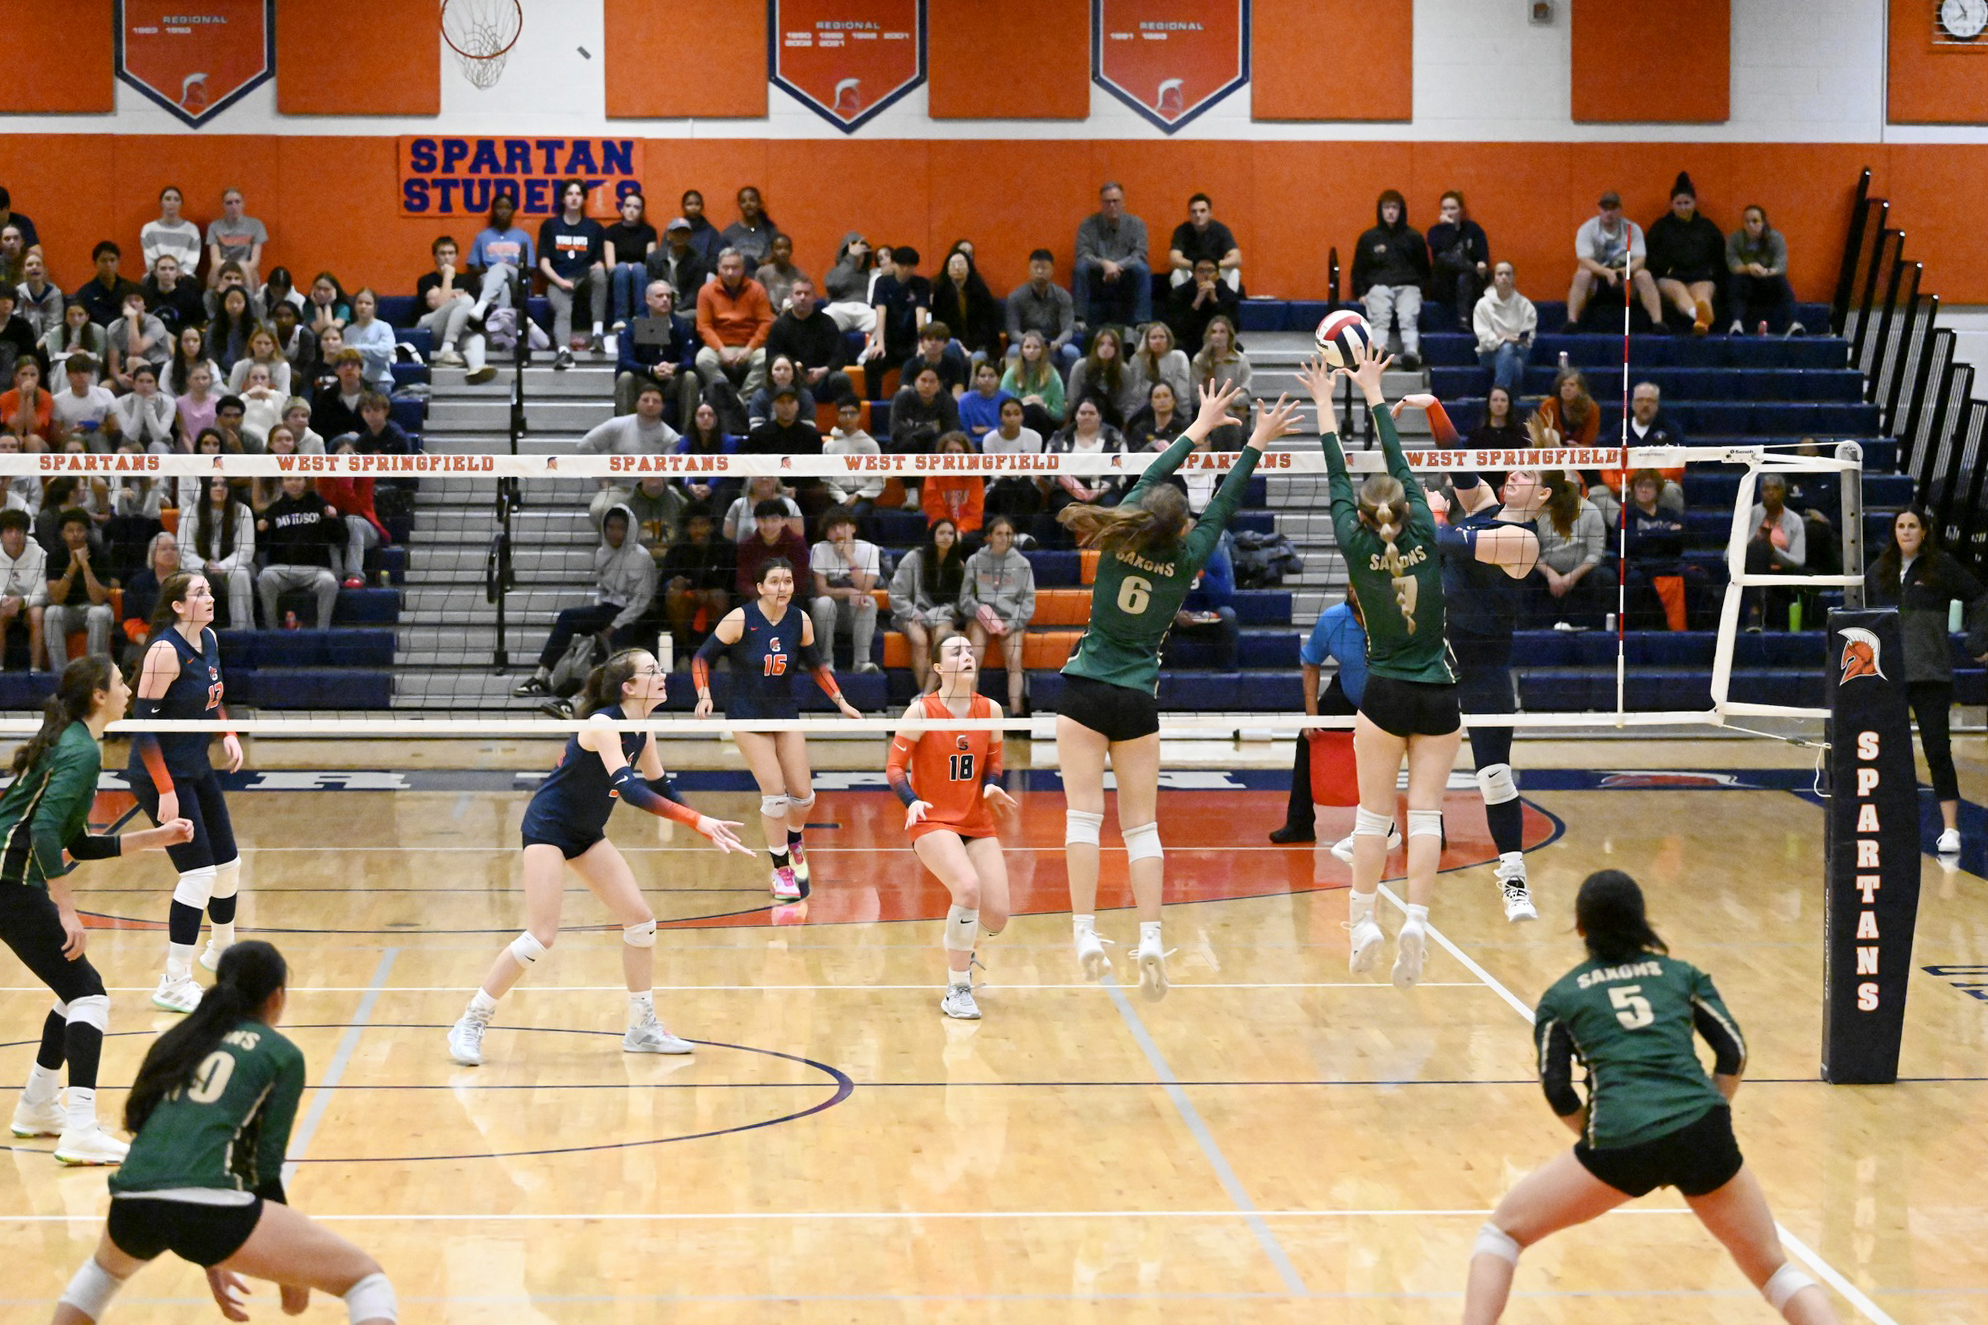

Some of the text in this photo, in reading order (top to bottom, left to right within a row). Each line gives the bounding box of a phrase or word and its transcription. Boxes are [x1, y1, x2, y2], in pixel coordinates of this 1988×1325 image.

[162, 15, 228, 24] REGIONAL
[815, 21, 880, 30] REGIONAL
[1139, 21, 1204, 31] REGIONAL
[410, 138, 634, 175] SPARTAN
[39, 455, 160, 471] SPARTANS
[276, 455, 494, 472] WEST SPRINGFIELD
[609, 456, 729, 472] SPARTANS
[844, 454, 1059, 471] WEST SPRINGFIELD
[1405, 448, 1618, 467] WEST SPRINGFIELD
[1369, 545, 1427, 571] SAONS
[1116, 575, 1153, 615] 6
[1391, 574, 1418, 616] 7
[763, 653, 788, 677] 16
[949, 753, 975, 782] 18
[1855, 730, 1881, 1012] SPARTANS
[1576, 961, 1663, 989] SAXONS
[1607, 984, 1655, 1031] 5
